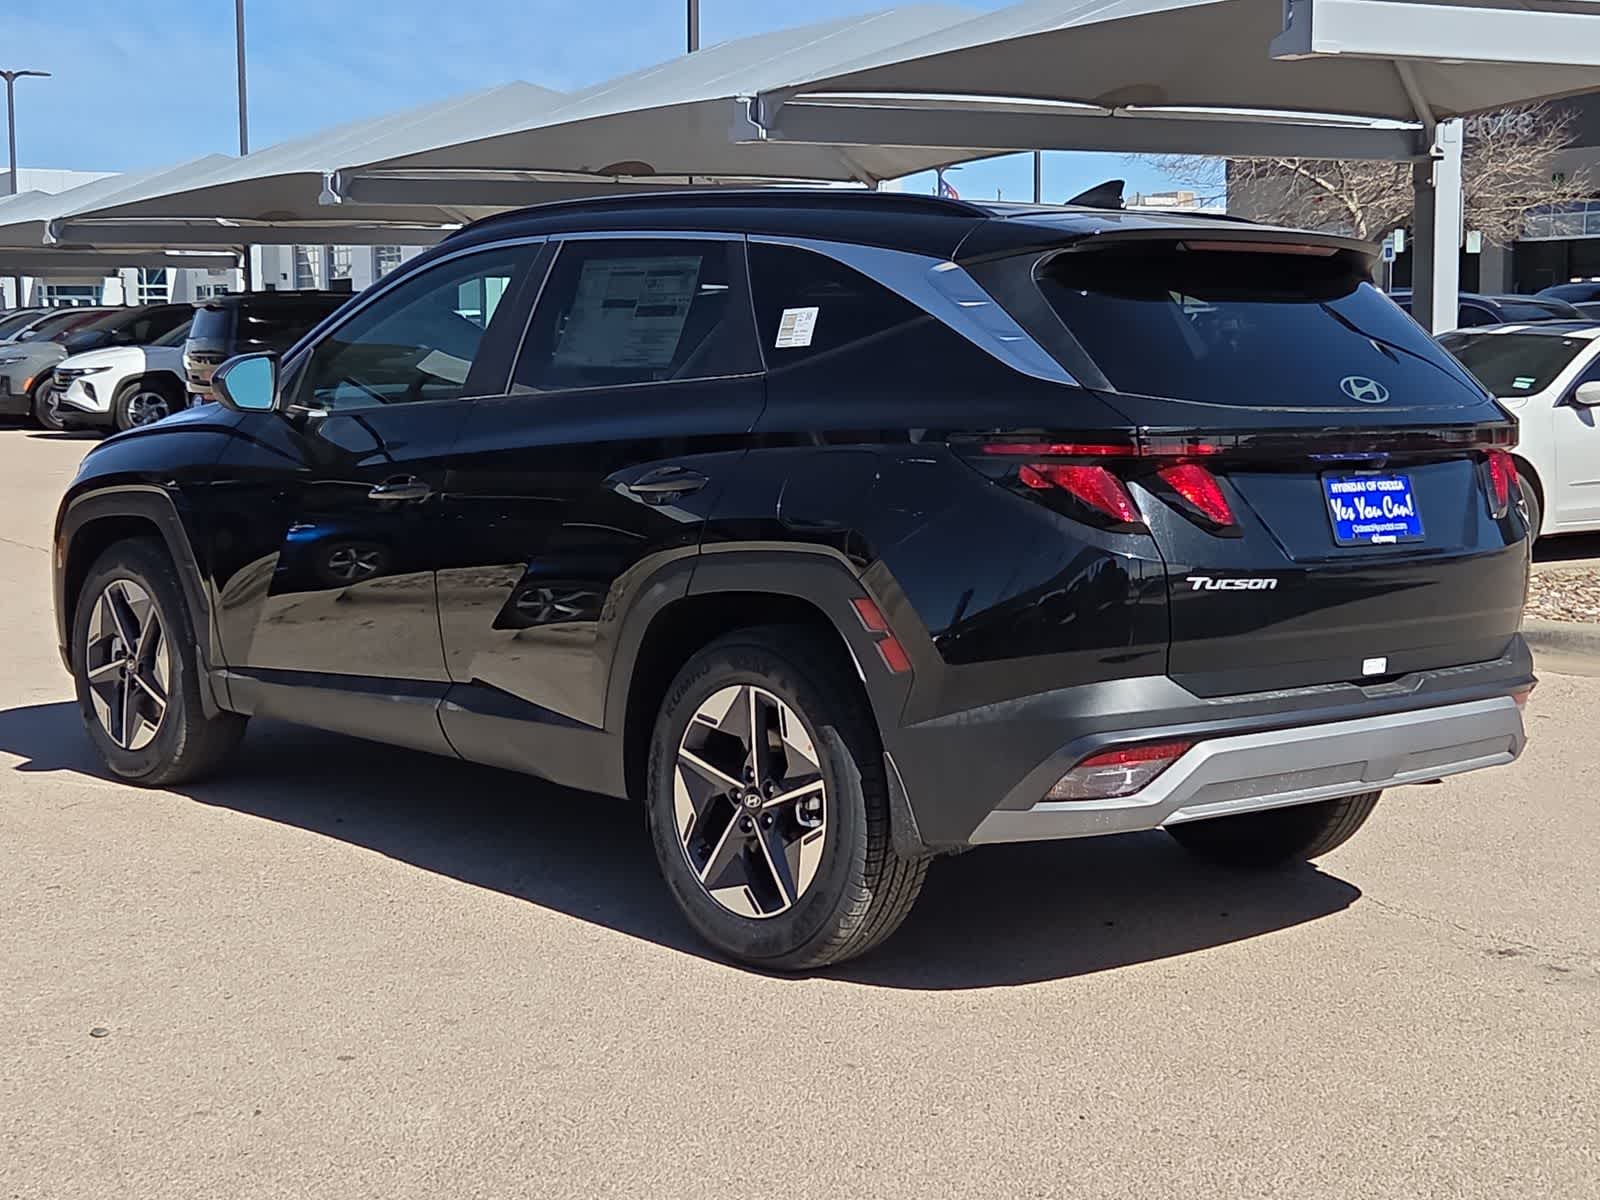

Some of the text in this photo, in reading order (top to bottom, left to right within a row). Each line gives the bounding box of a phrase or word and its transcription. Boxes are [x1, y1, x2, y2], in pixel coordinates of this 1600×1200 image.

[1463, 111, 1535, 139] ervice
[1330, 482, 1366, 493] HYUNDAI
[1366, 481, 1377, 491] OF
[1330, 493, 1414, 521] Yes You Can!
[1186, 576, 1278, 590] Tucson
